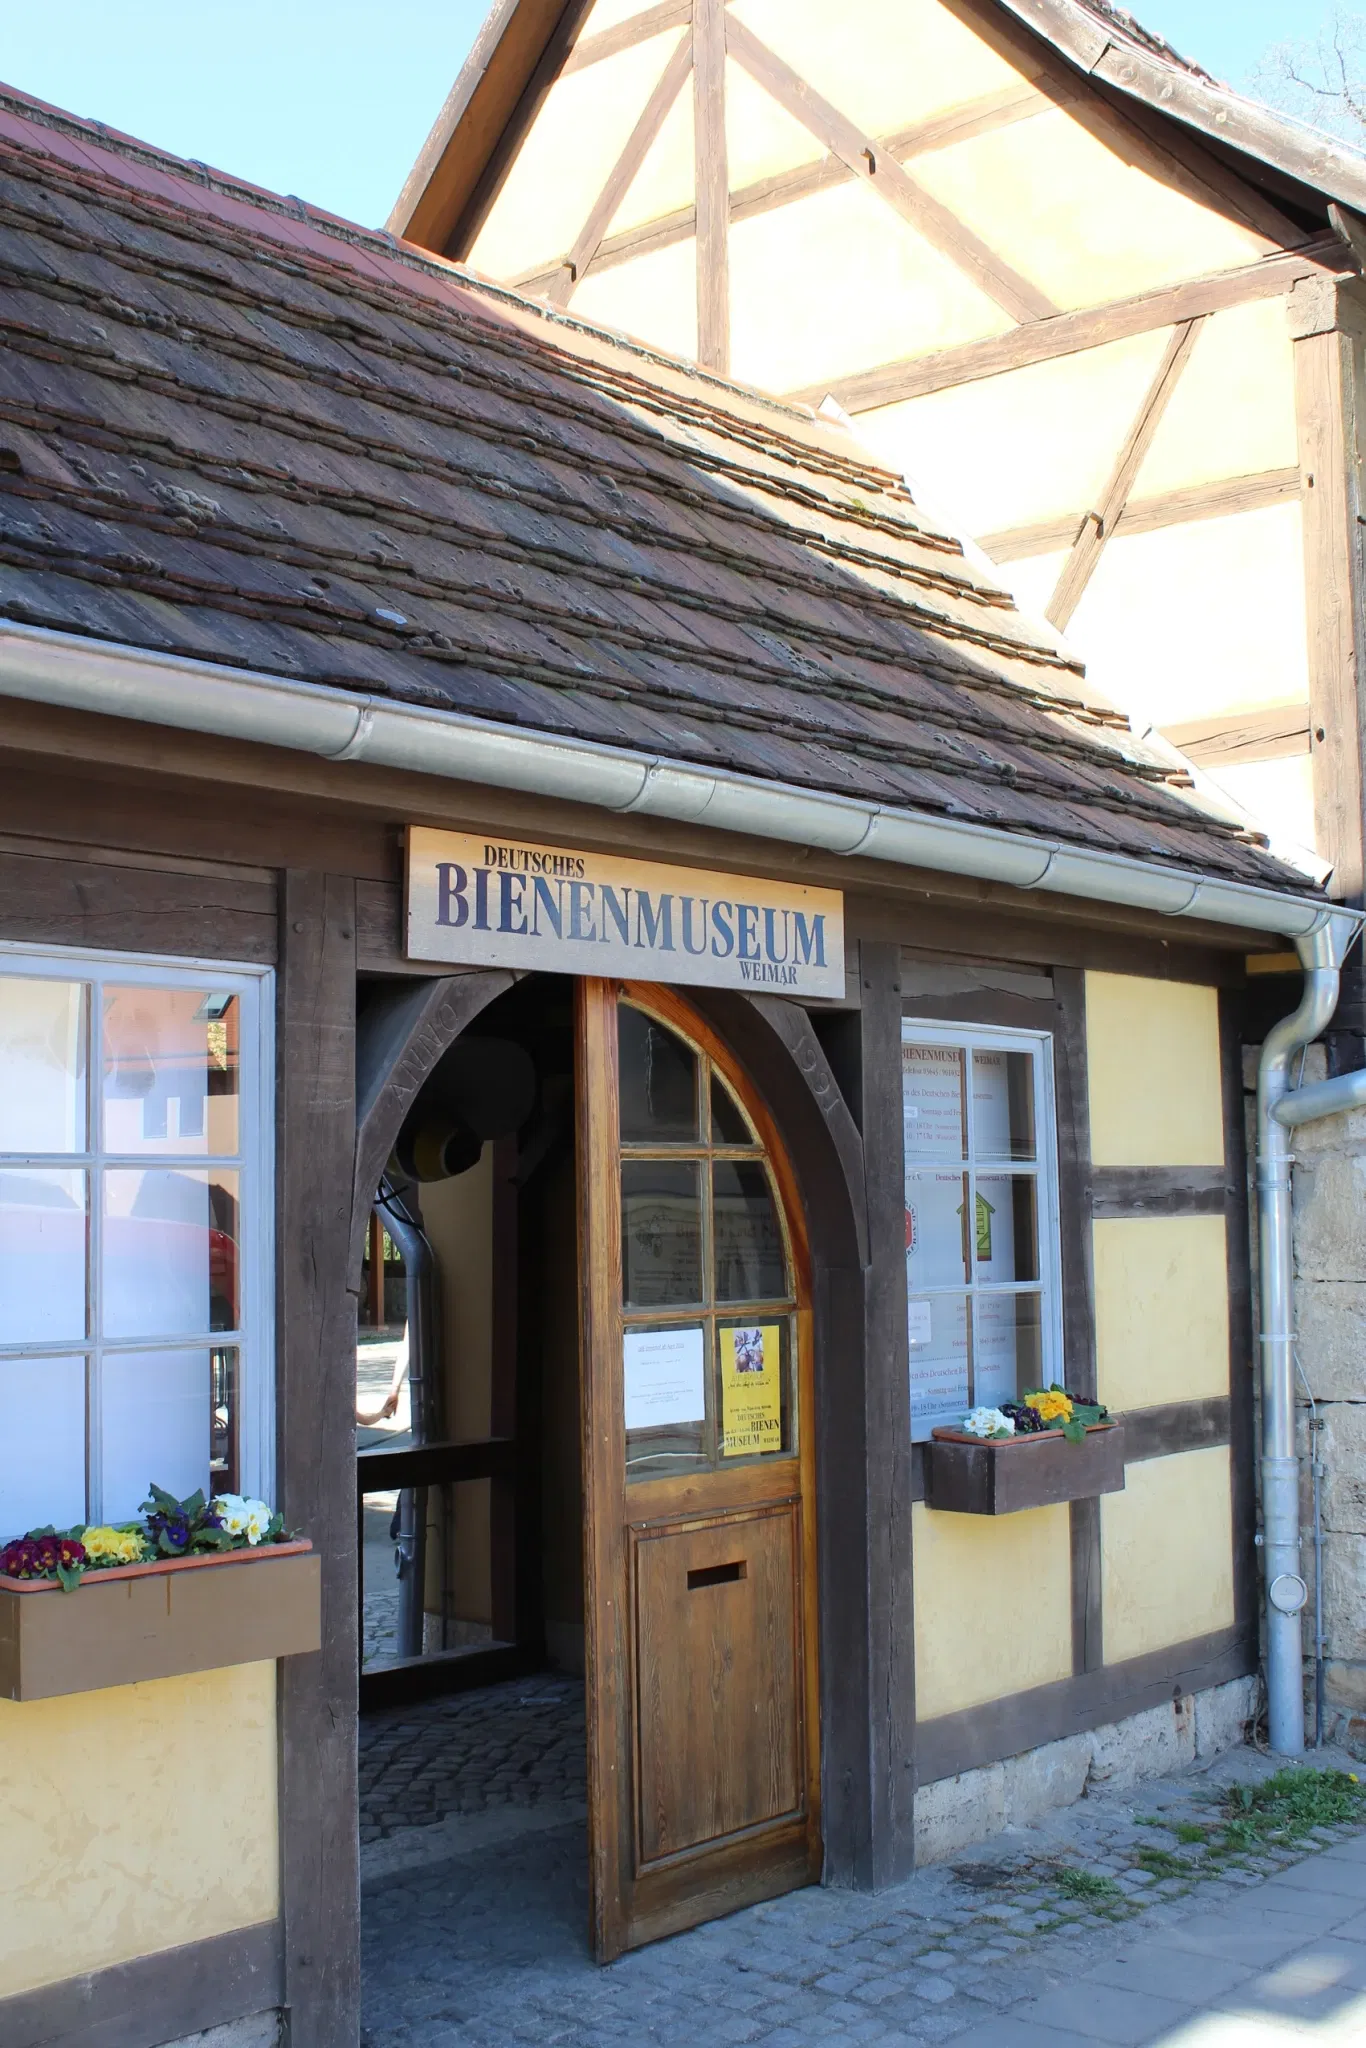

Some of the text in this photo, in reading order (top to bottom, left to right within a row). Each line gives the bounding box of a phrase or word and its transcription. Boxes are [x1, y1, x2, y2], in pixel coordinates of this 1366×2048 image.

[483, 844, 585, 878] DEUTSCHES
[435, 862, 828, 968] BIENENMUSEUM
[739, 960, 798, 985] WEIMAR
[389, 1003, 459, 1112] ANNO
[902, 1047, 961, 1063] BIENENMUSE
[737, 1412, 766, 1421] DEUTSCHES
[751, 1418, 779, 1433] BIENEN
[726, 1433, 760, 1448] MUSEUM
